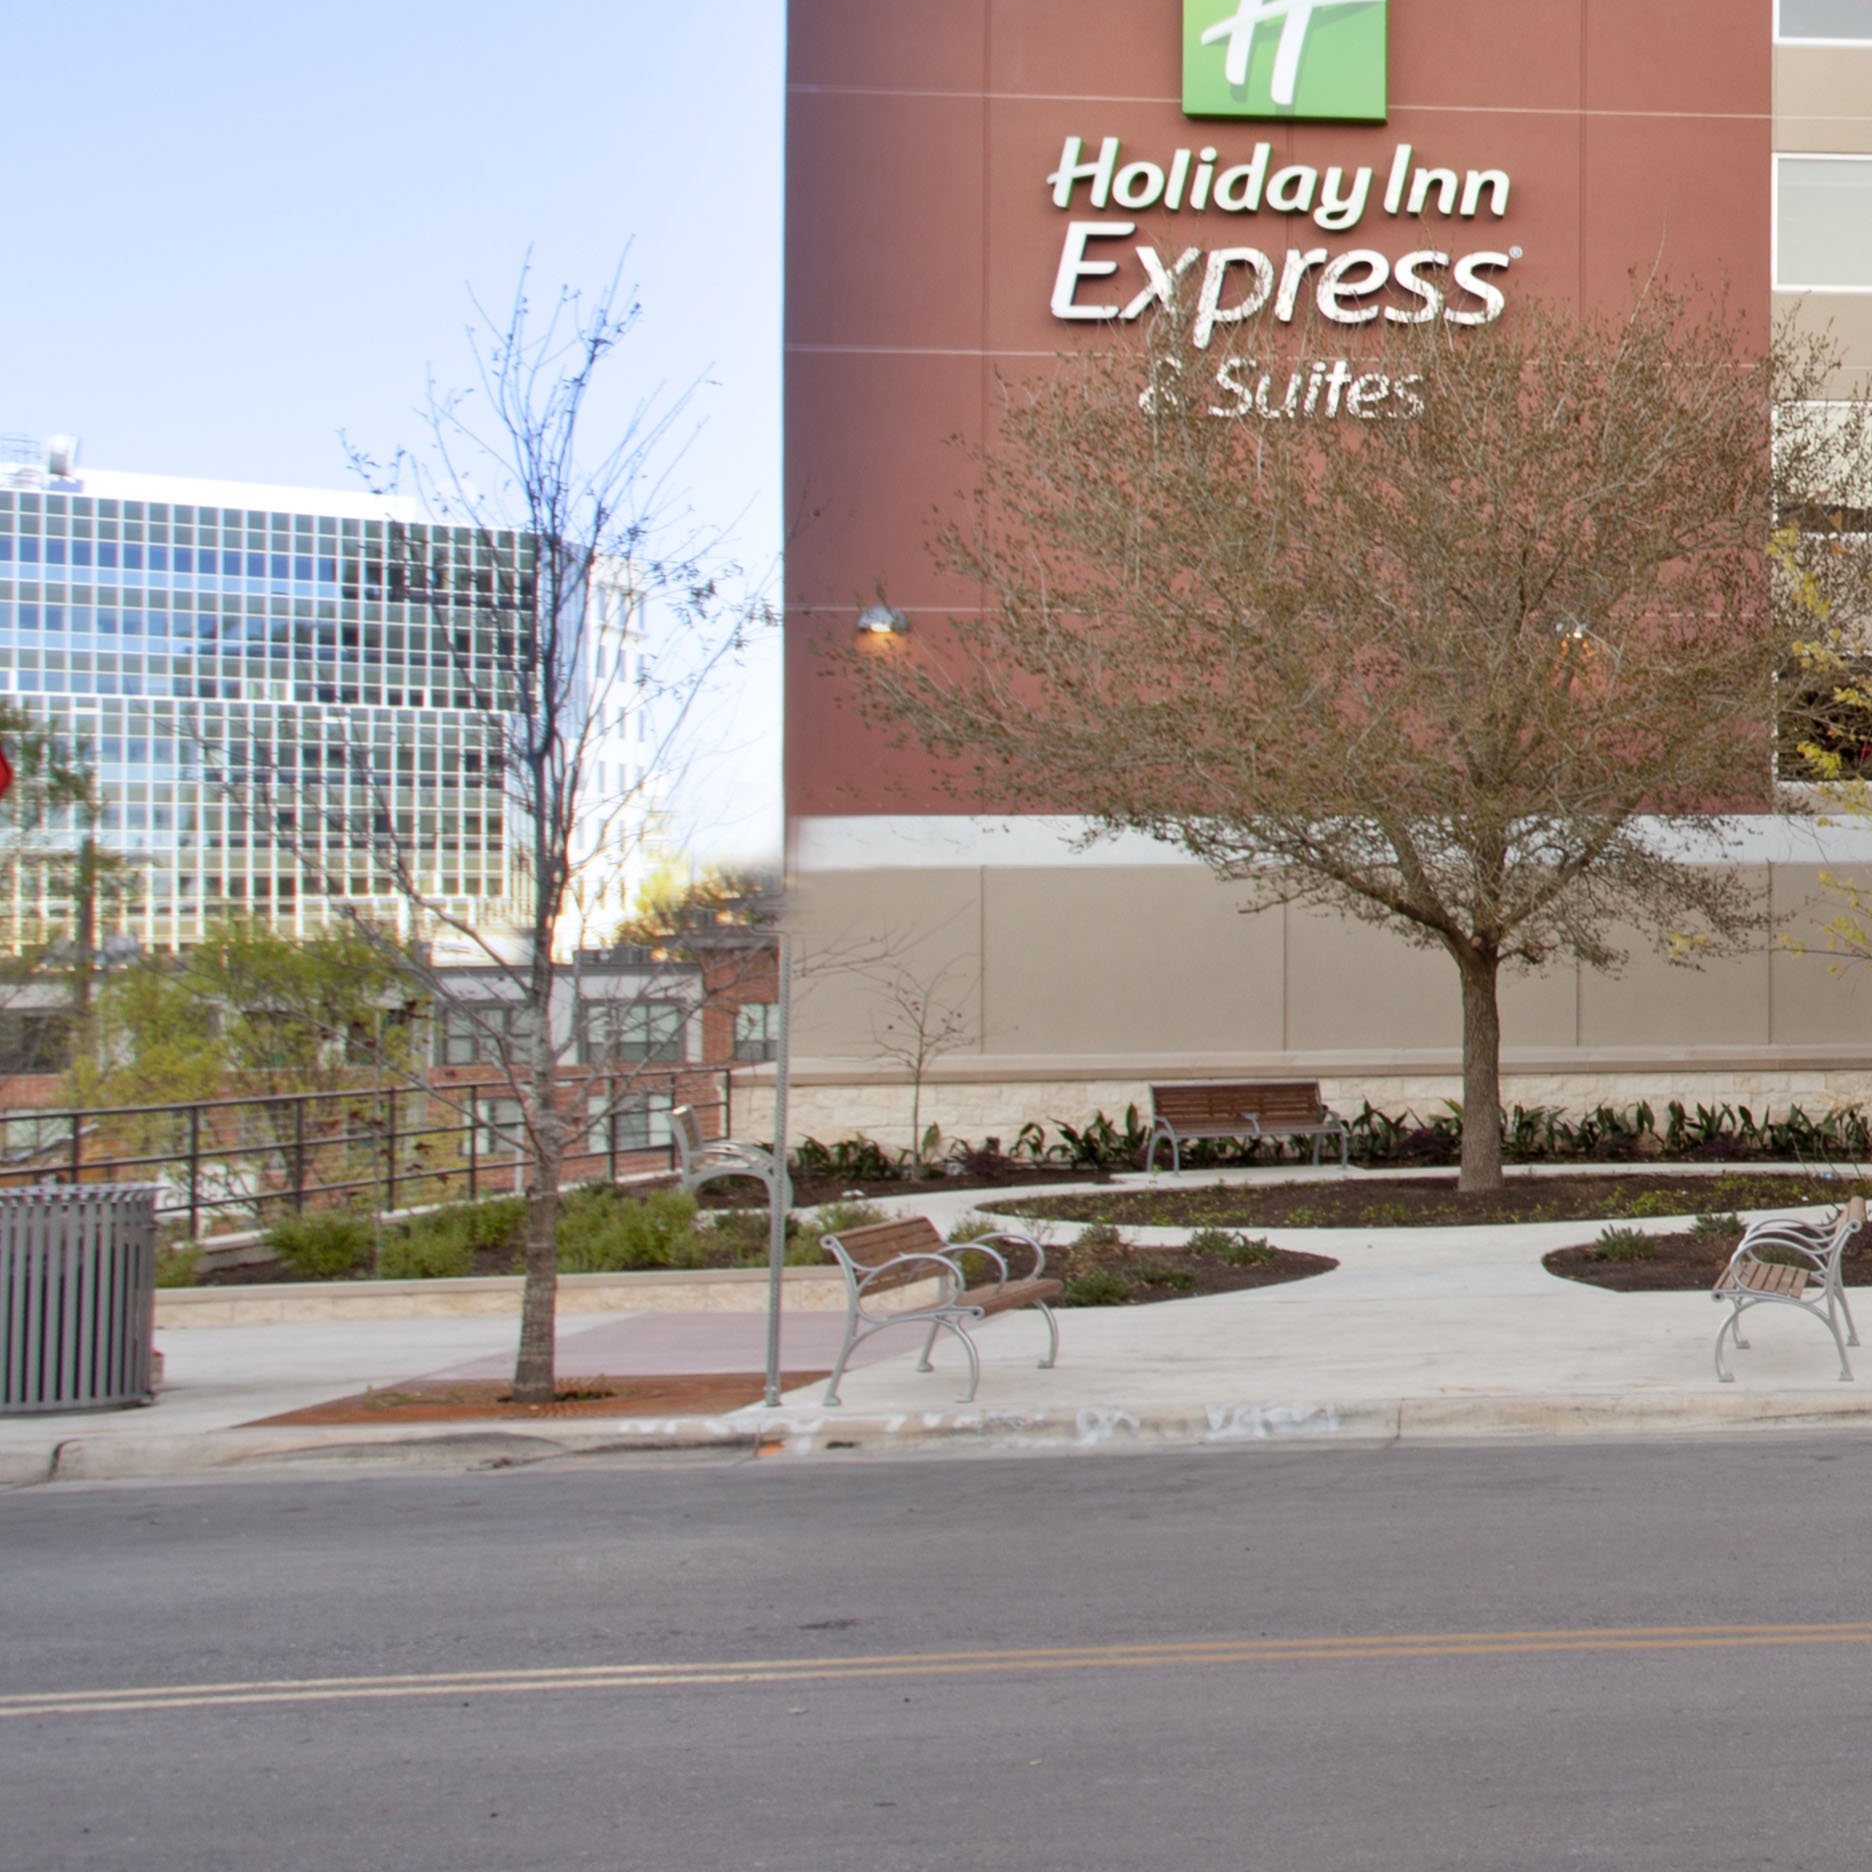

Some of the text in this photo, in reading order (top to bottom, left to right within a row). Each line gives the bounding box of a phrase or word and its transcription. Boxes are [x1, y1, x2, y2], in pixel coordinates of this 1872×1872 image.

[1046, 136, 1511, 231] Holiday Inn
[1050, 221, 1510, 349] Express
[1207, 357, 1426, 420] Suites
